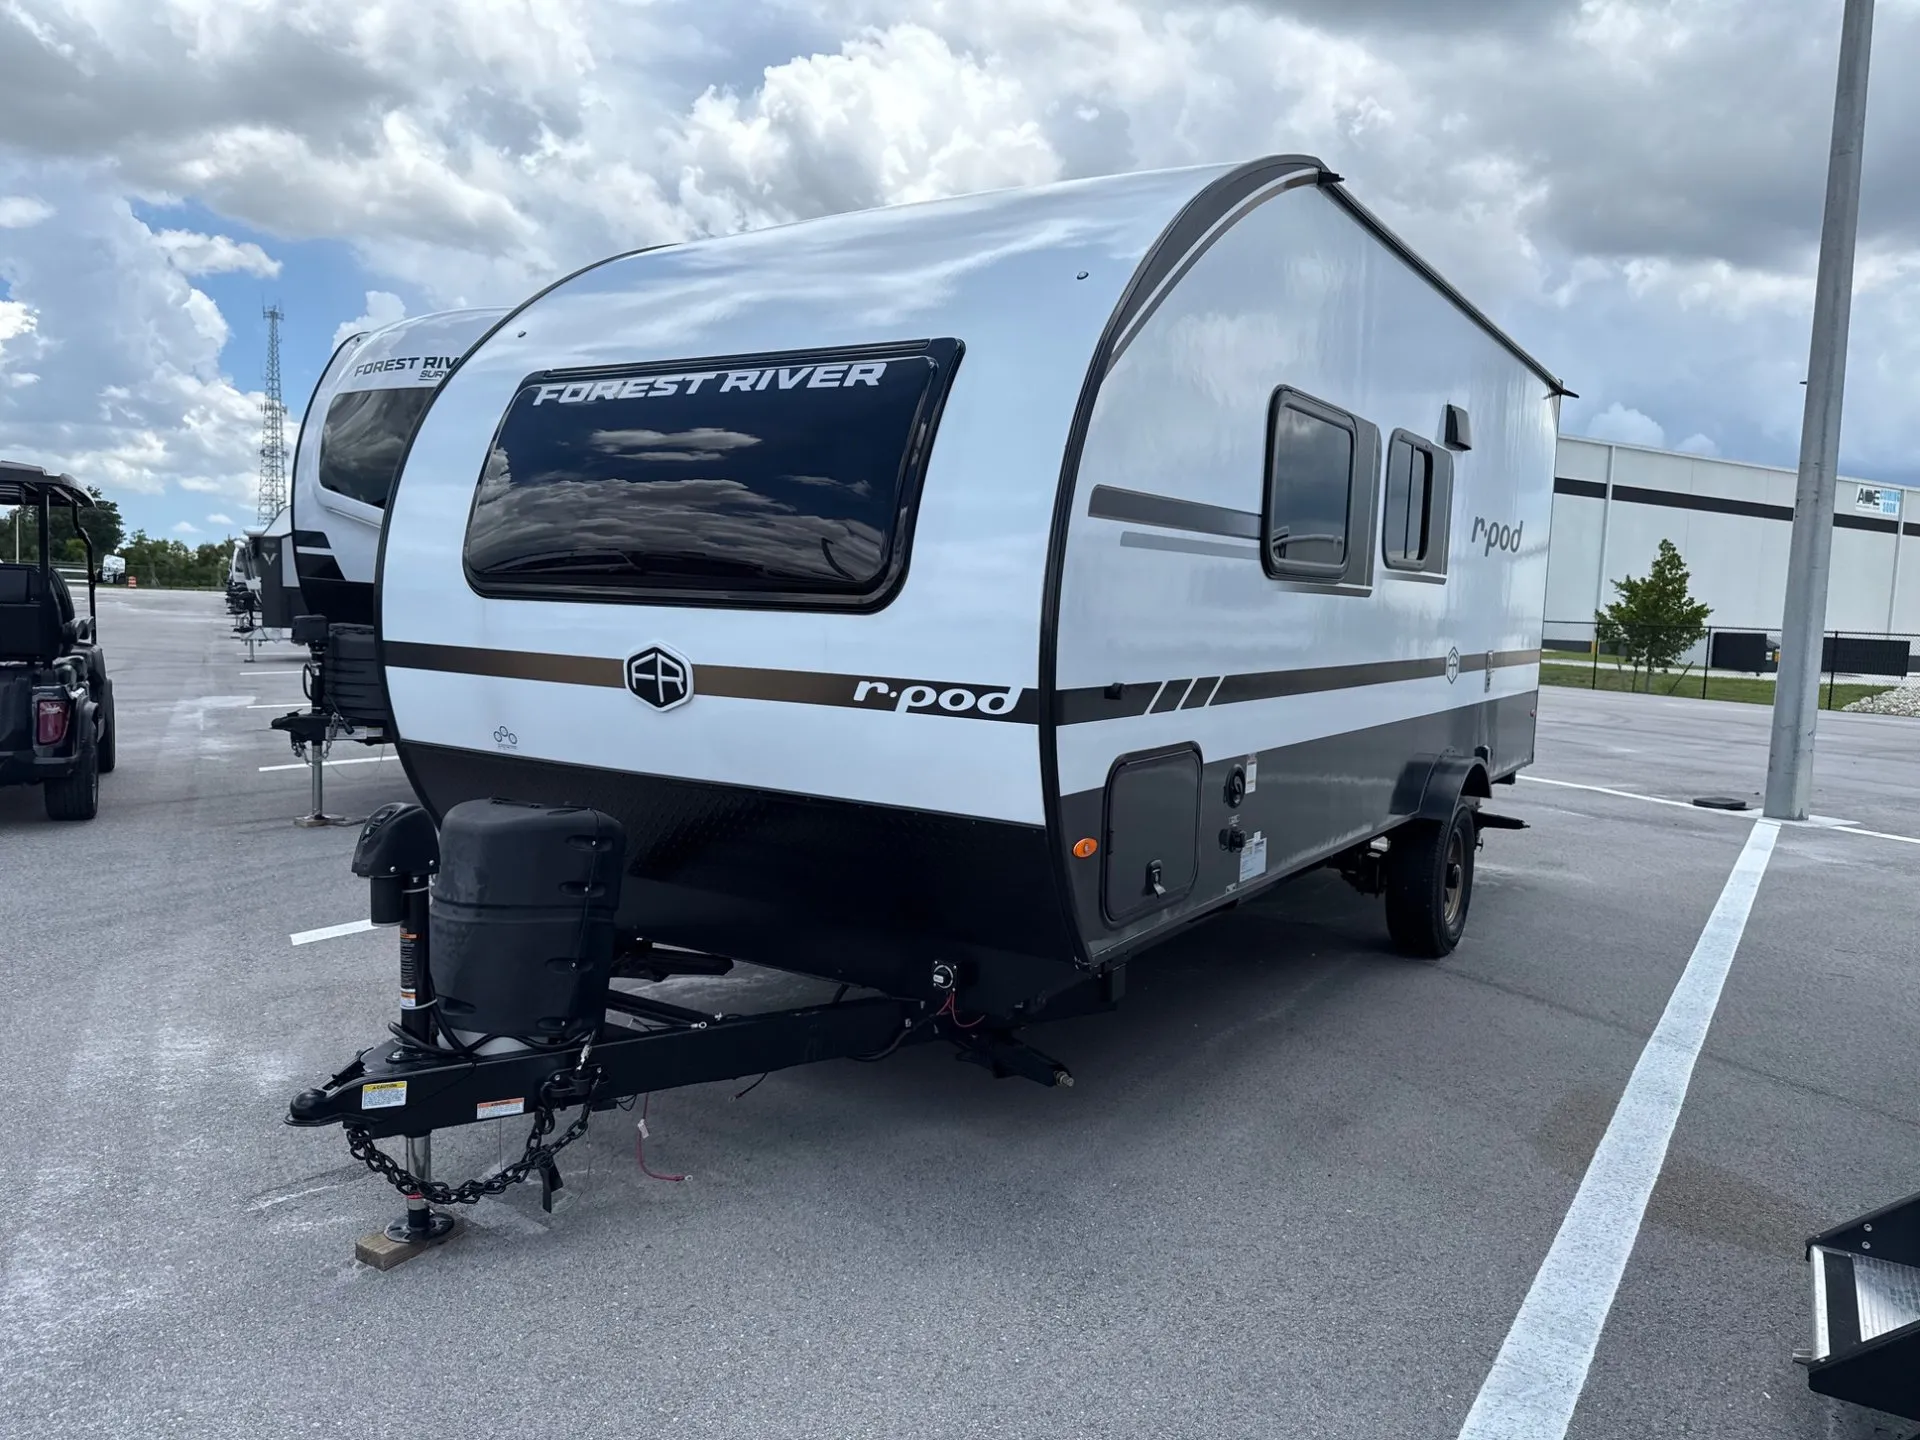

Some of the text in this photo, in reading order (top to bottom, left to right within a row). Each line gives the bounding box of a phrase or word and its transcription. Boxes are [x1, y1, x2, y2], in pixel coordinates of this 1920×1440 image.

[354, 357, 420, 377] FOREST
[532, 362, 888, 406] FOREST RIVER
